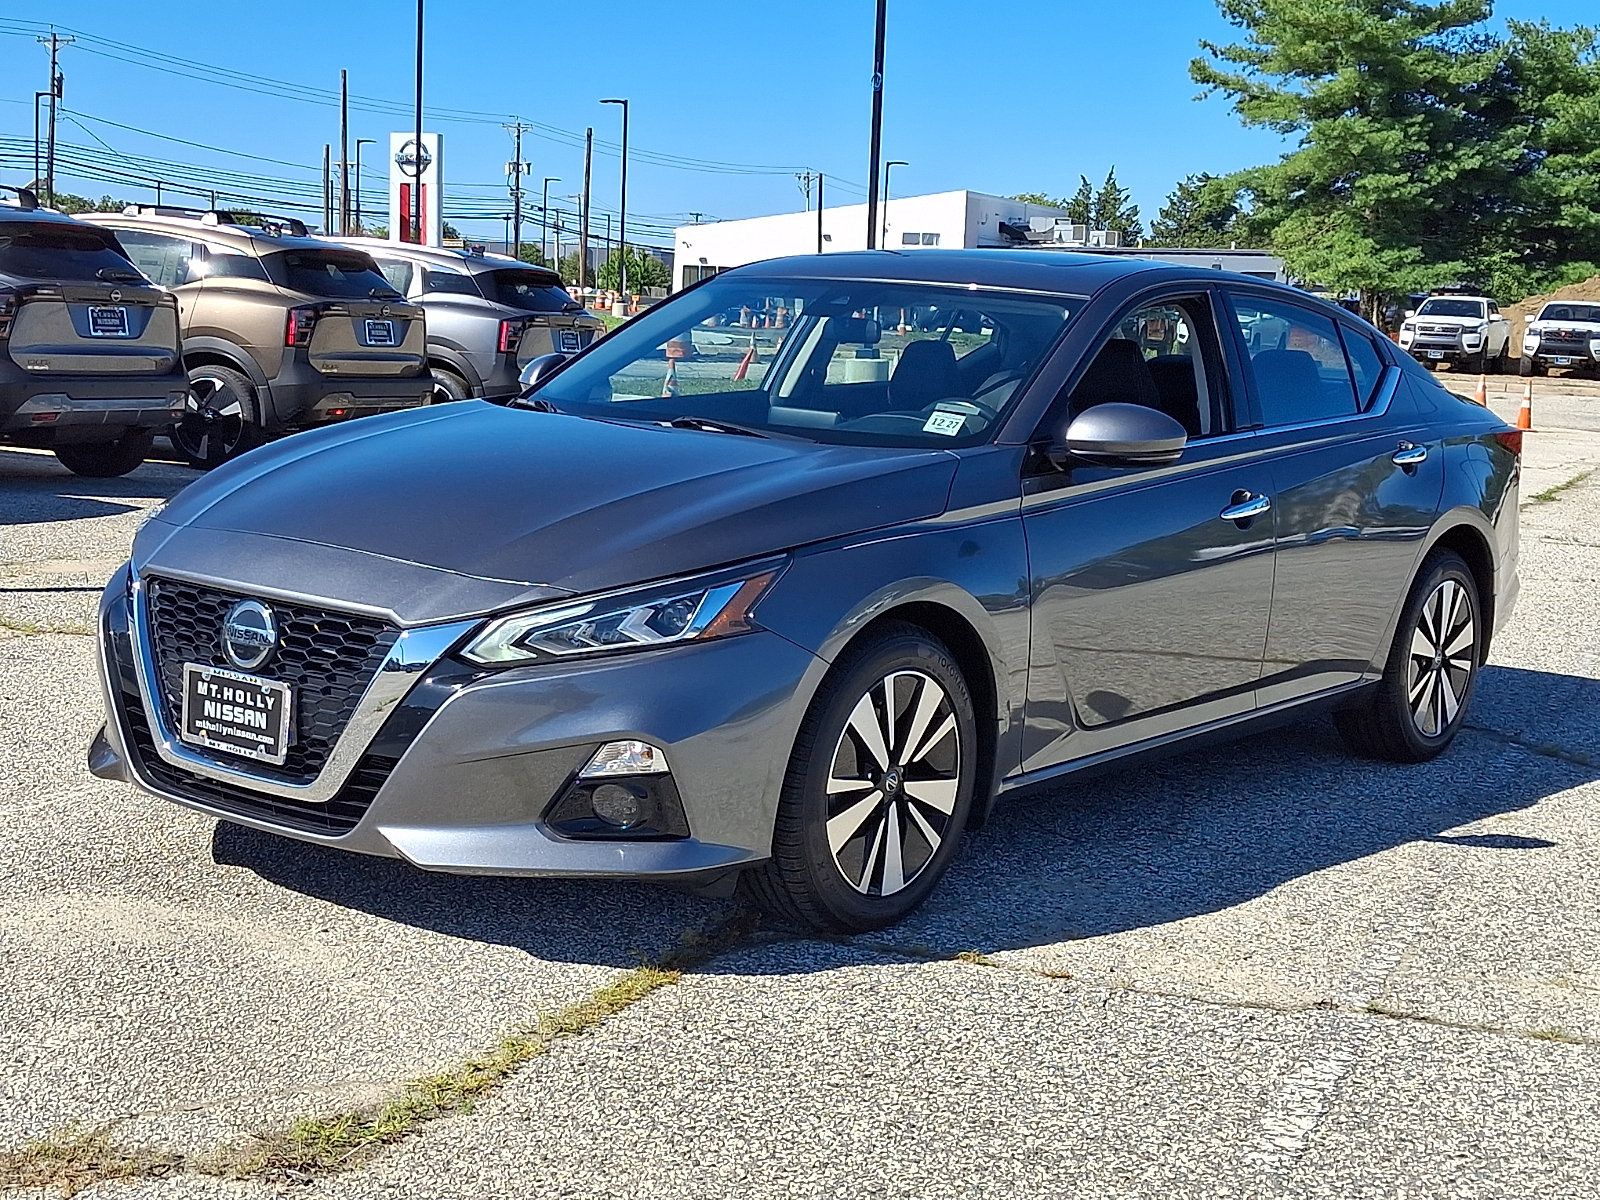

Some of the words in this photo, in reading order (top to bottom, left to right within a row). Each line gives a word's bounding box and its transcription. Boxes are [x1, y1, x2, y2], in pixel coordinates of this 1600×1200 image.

[932, 417, 945, 426] 12
[946, 421, 959, 429] 27
[226, 624, 270, 645] NISSAN
[204, 699, 267, 730] NISSAN
